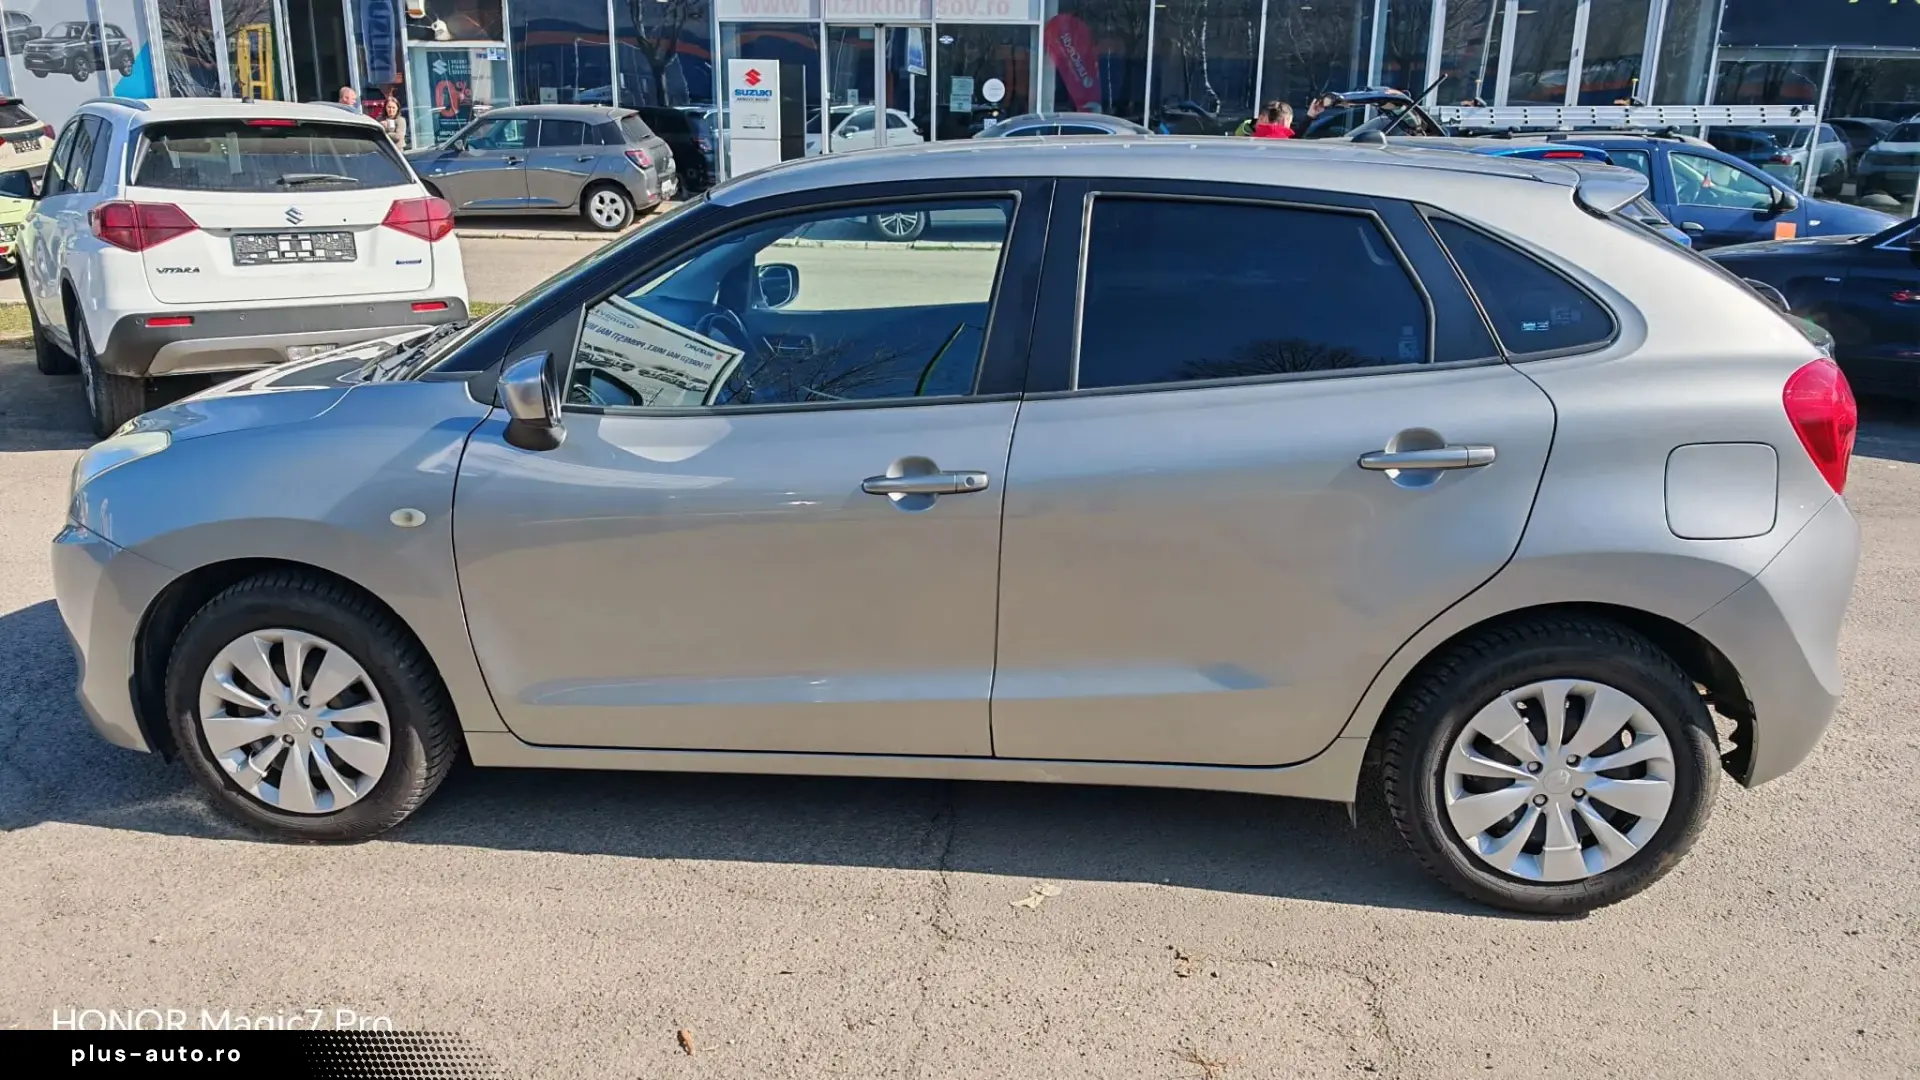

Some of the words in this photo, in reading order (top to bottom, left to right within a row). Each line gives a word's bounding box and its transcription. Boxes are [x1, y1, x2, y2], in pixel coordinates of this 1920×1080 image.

[741, 0, 1010, 16] www.uzukibrsov.ro
[368, 0, 393, 71] UZUKI
[734, 88, 773, 97] SUZUKI
